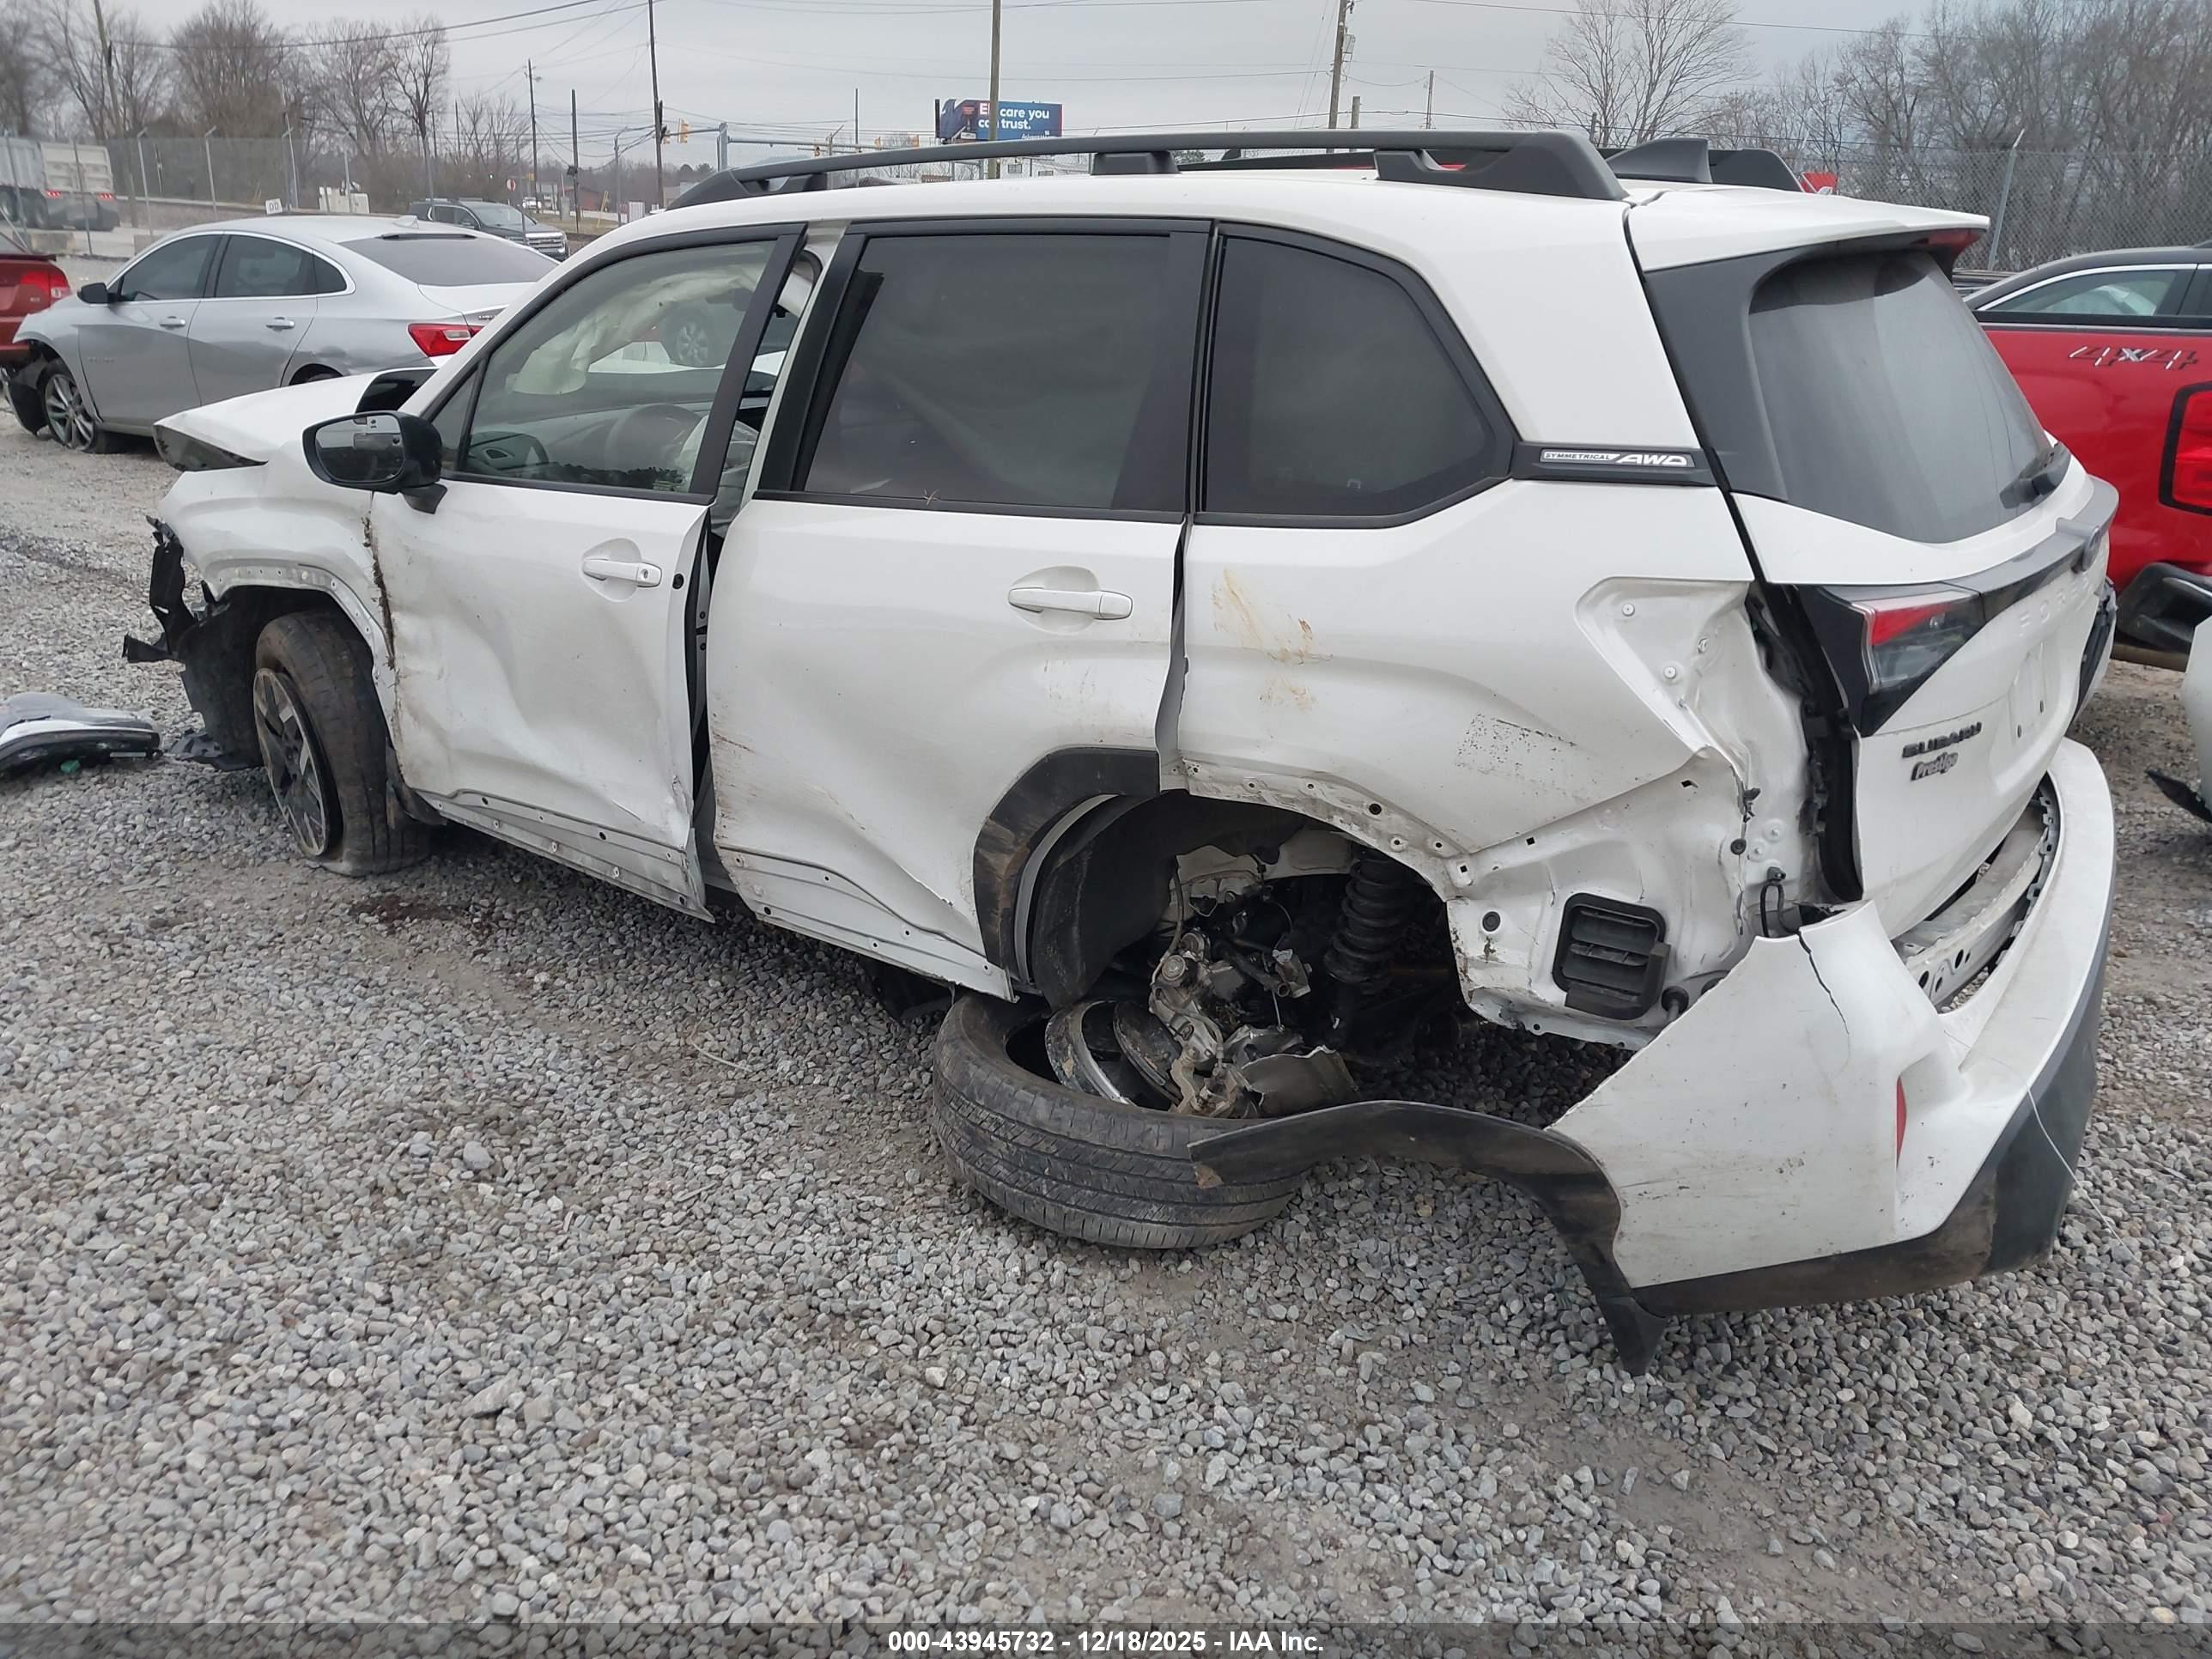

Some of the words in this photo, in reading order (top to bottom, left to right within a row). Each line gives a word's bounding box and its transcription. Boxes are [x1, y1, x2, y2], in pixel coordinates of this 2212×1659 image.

[1000, 108, 1025, 118] care
[1029, 110, 1049, 121] you
[1001, 118, 1031, 130] trust.
[1545, 452, 1610, 461] SYMMETRICAL
[1615, 453, 1687, 466] AWD
[1902, 721, 1982, 758] SUBARU
